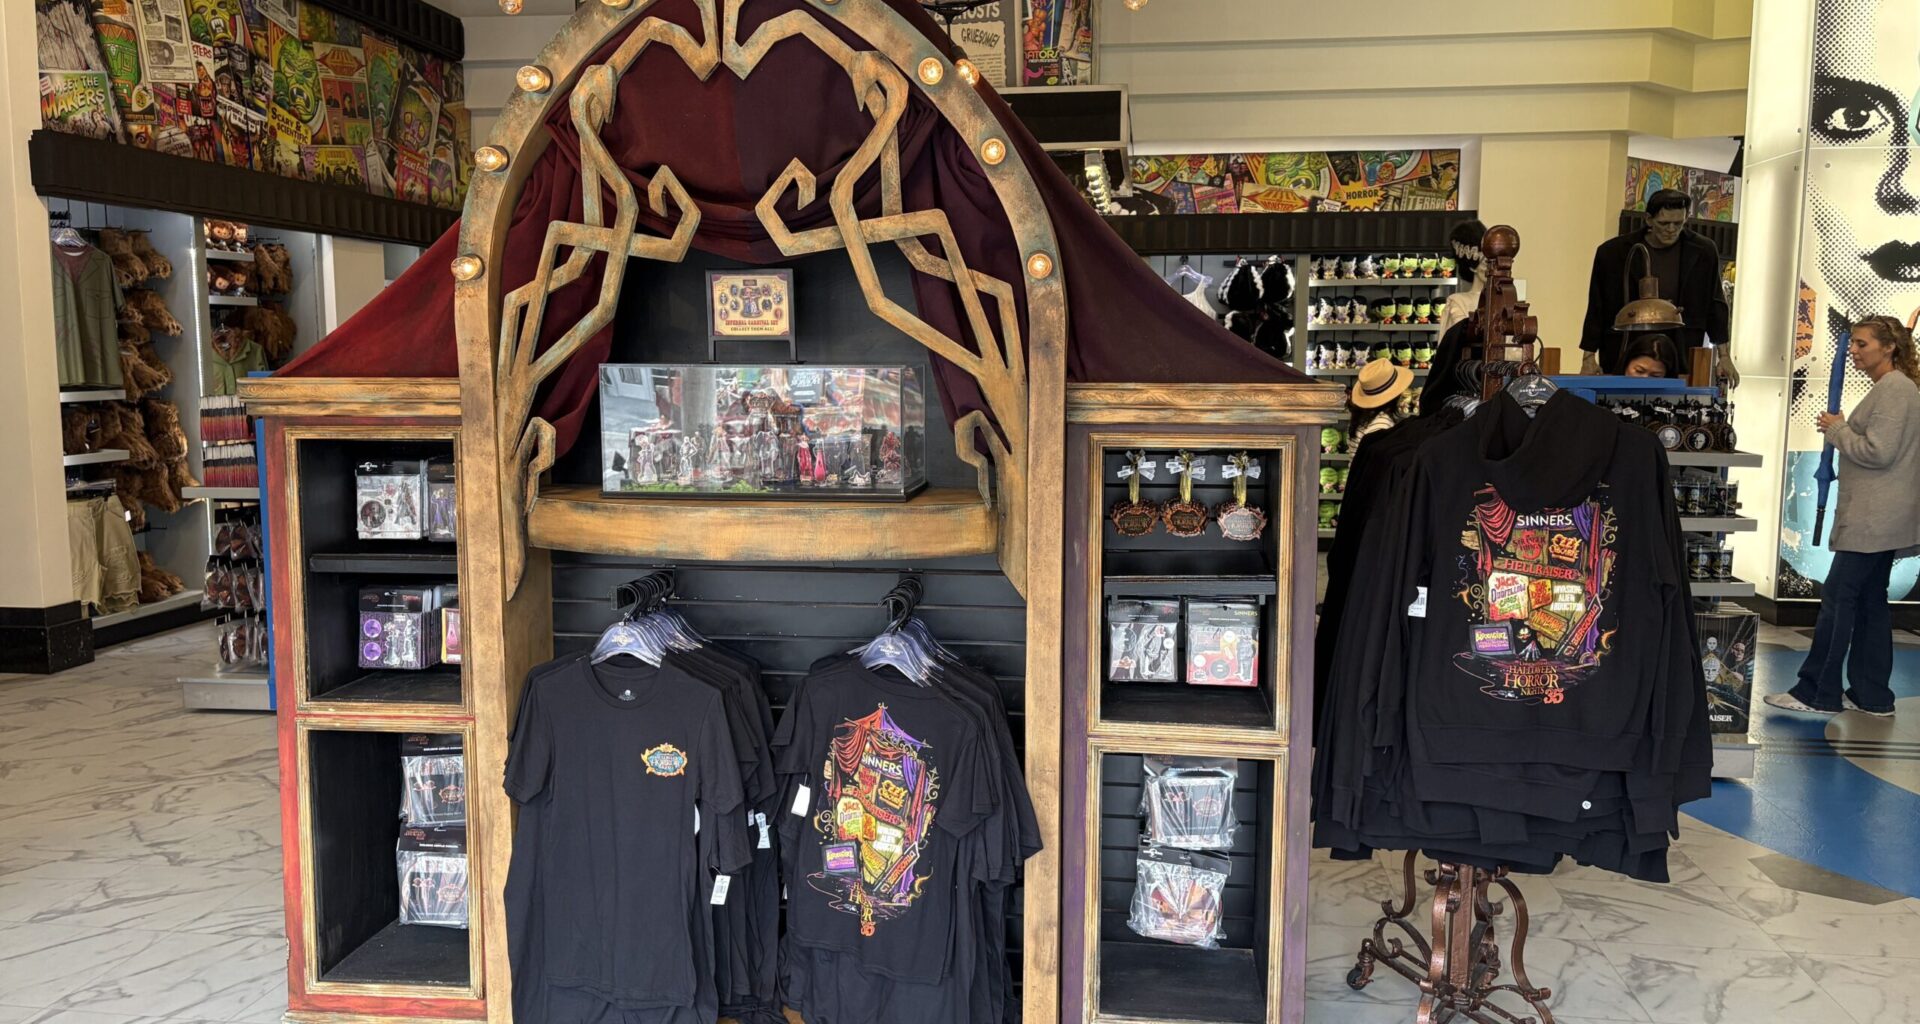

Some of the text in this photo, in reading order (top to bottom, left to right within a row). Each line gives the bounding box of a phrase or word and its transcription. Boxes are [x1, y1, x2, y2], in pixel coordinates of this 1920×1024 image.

[961, 27, 1000, 49] GRUESOME!
[54, 75, 99, 94] MEET THE
[42, 89, 106, 120] MAKERS
[271, 106, 294, 127] SCARY
[295, 120, 302, 131] &
[277, 122, 309, 145] SCIENTIFIC
[1346, 189, 1380, 201] HORROR
[1504, 557, 1575, 580] HELLRAISER
[1495, 576, 1519, 590] JACK
[1509, 665, 1558, 675] HALLOWEEN
[1503, 673, 1559, 689] HORROR
[1520, 687, 1545, 696] NIGHTS
